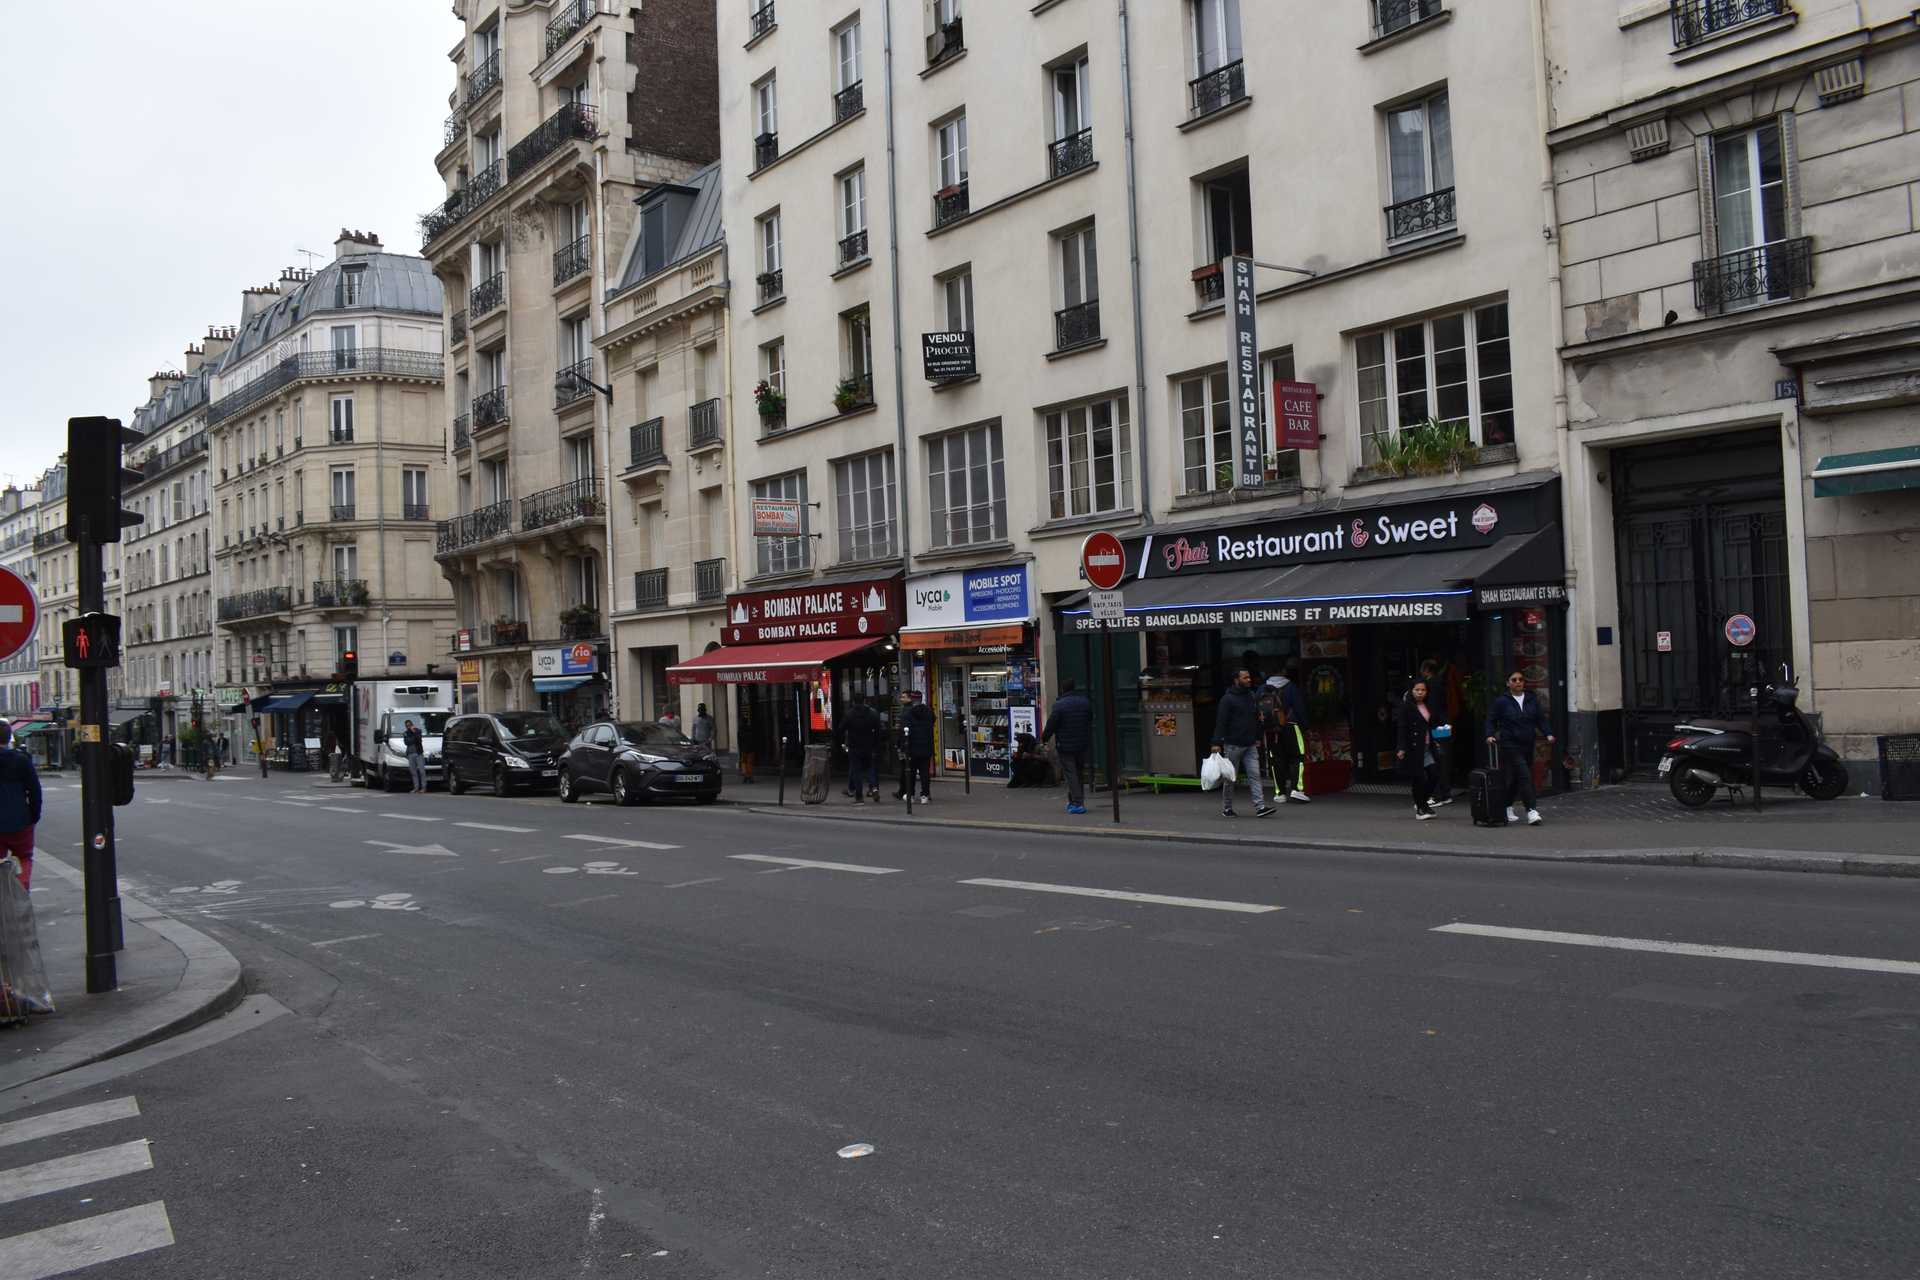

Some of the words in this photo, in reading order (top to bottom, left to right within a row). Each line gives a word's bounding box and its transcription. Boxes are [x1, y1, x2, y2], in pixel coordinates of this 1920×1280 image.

[1237, 261, 1250, 316] SHAH
[928, 333, 965, 344] VENDU
[1777, 381, 1797, 397] 15
[1240, 331, 1256, 470] RESTAURANT
[1284, 400, 1312, 412] CAFE
[1289, 418, 1312, 431] BAR
[1243, 474, 1262, 485] BIP
[757, 511, 784, 520] BOMBAY
[1163, 537, 1210, 570] Shah
[1218, 524, 1344, 561] Restaurant
[1351, 518, 1369, 548] &
[1375, 511, 1458, 545] Sweet
[969, 576, 999, 591] MOBILE
[1000, 574, 1021, 586] SPOT
[916, 589, 942, 607] Lyca
[1481, 589, 1499, 603] SHAH
[1500, 587, 1537, 602] RESTAURANT
[1539, 586, 1546, 599] ET
[764, 597, 802, 618] BOMBAY
[805, 592, 843, 615] PALACE
[1076, 616, 1140, 630] SPECALITES
[1146, 612, 1224, 627] BANGLADAISE
[1231, 608, 1297, 623] INDIENNES
[1305, 608, 1322, 620] ET
[1329, 603, 1443, 619] PAKISTANAISES
[758, 625, 796, 639] BOMBAY
[800, 622, 837, 636] PALACE
[717, 672, 742, 682] BOMBAY
[743, 671, 767, 681] PALACE
